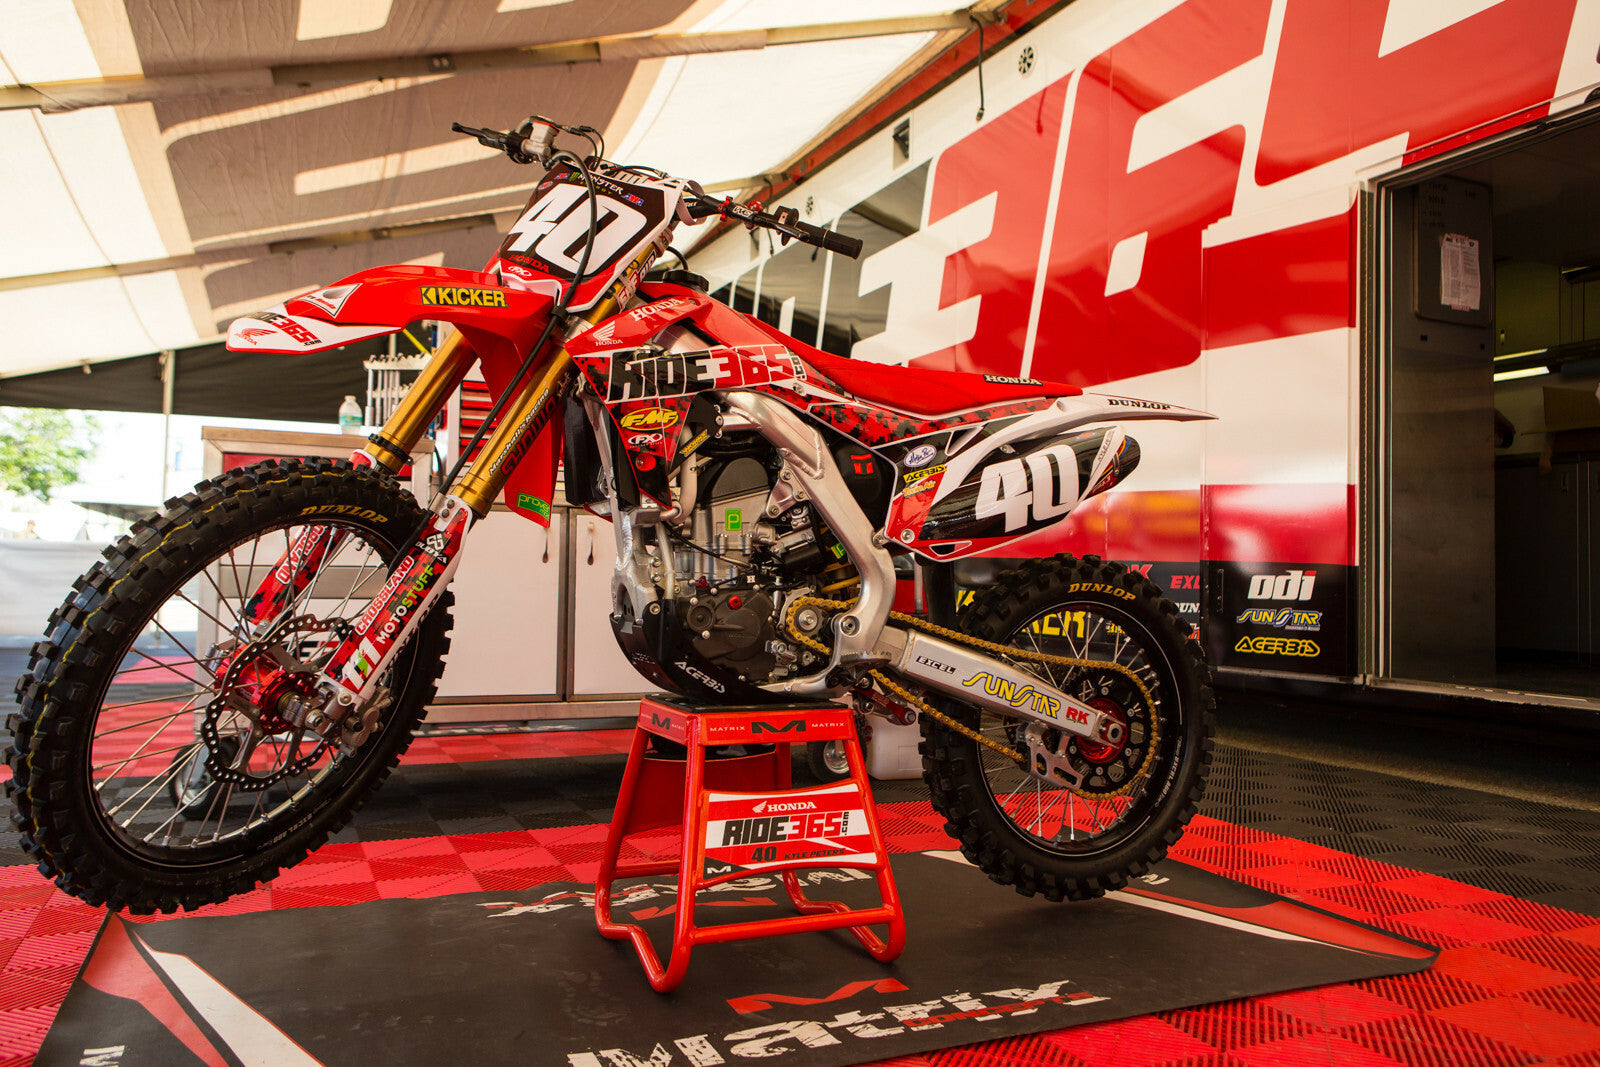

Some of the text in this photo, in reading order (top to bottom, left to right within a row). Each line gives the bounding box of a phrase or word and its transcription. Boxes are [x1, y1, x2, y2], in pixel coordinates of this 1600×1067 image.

[577, 173, 623, 194] MNSTER
[507, 183, 647, 276] 40
[509, 254, 550, 273] HONDA
[439, 287, 506, 307] KICKER
[629, 297, 685, 322] HONDA
[595, 338, 623, 346] HONDA
[984, 374, 1042, 386] HONDA
[1108, 399, 1171, 411] DUNLOP
[622, 409, 679, 428] FMF
[975, 444, 1079, 533] 40
[300, 504, 388, 523] DUNLOP
[1068, 582, 1136, 601] DUNLOP
[1247, 570, 1317, 601] odi
[355, 555, 414, 636] CROSSLAND
[917, 656, 956, 673] EXCEL
[1066, 706, 1090, 725] RK
[767, 801, 817, 812] HONDA
[722, 812, 841, 847] RIDE365
[751, 846, 846, 862] 40 KYLE PETERS
